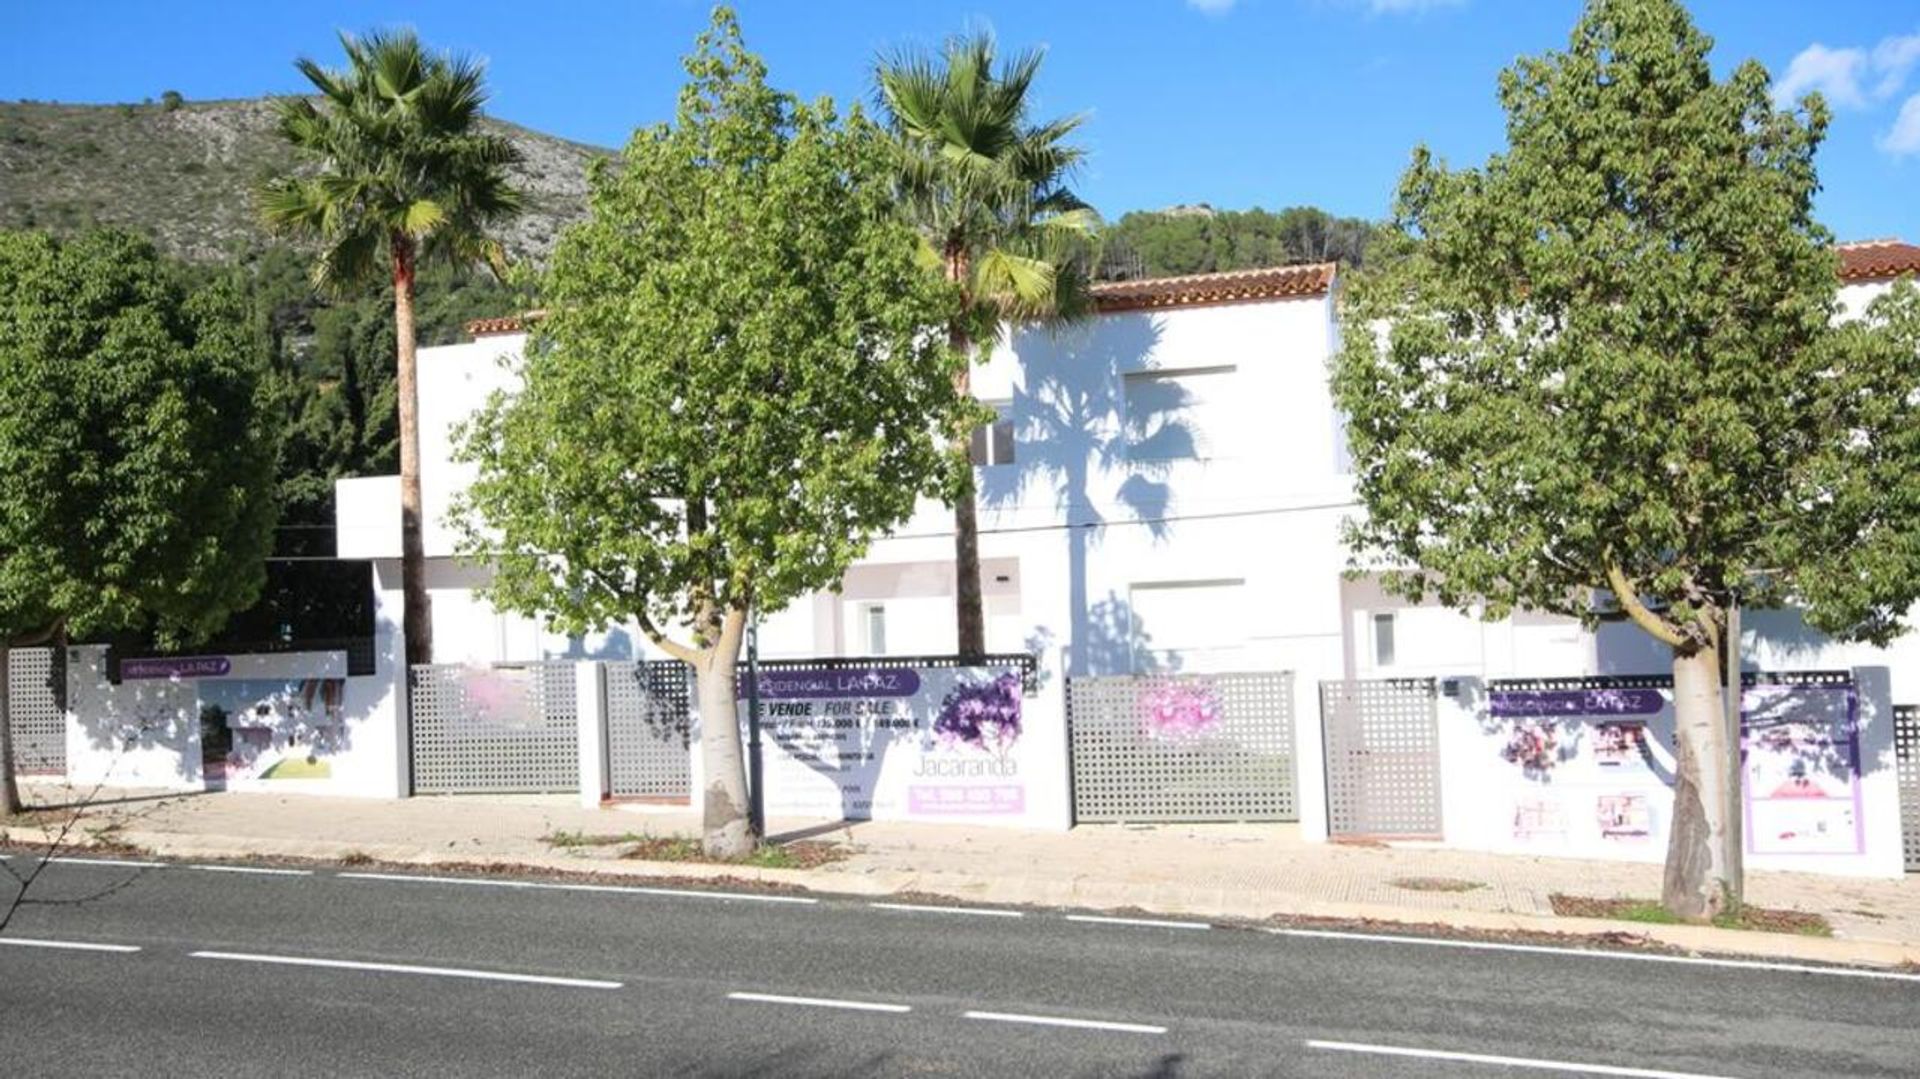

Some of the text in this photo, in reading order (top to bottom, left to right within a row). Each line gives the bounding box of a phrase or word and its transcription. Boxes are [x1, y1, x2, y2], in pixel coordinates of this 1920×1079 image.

[769, 702, 812, 716] VENDE
[824, 702, 850, 716] FOR
[912, 755, 1018, 777] Jacaranda
